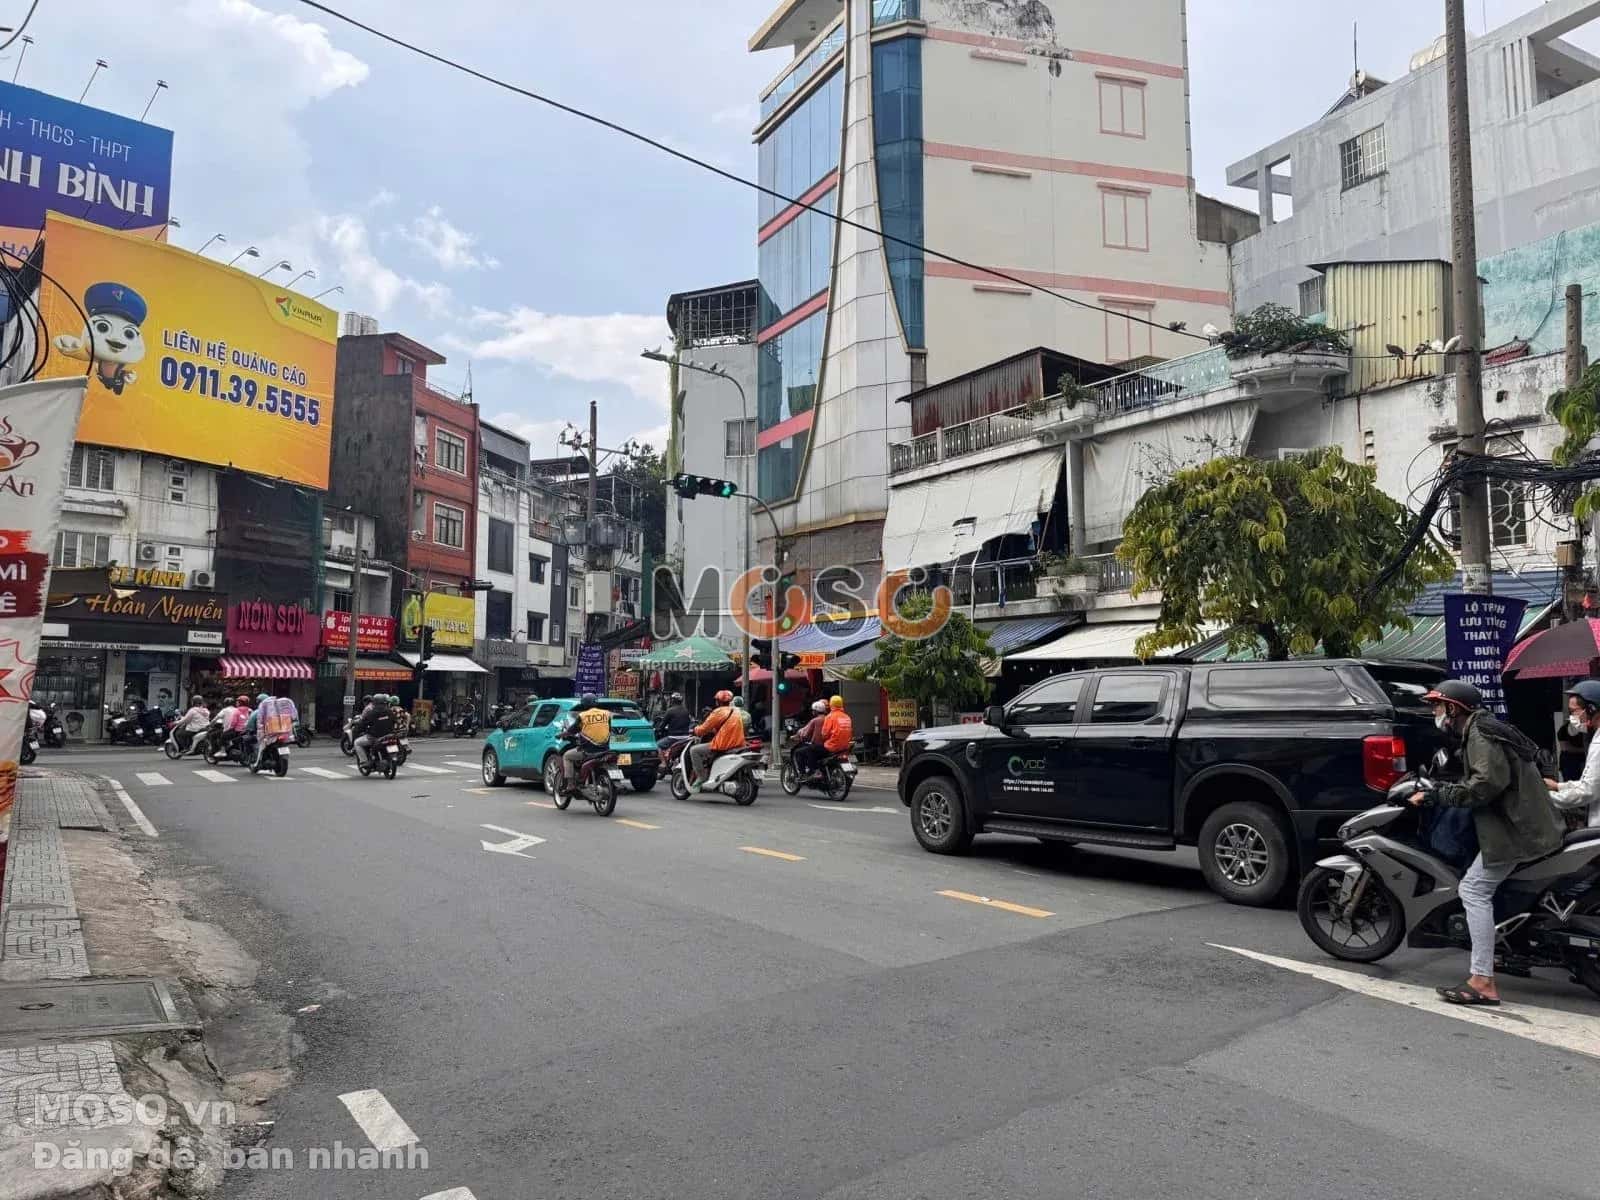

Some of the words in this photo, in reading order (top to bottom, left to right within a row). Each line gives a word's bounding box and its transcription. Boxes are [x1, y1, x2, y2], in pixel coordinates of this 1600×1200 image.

[29, 118, 74, 147] THCS
[91, 135, 132, 162] THPT
[57, 162, 155, 217] BÌNH
[163, 329, 201, 354] LIÊN
[206, 341, 227, 366] HỆ
[231, 349, 278, 377] QUẢNG
[281, 365, 307, 386] CÁO
[160, 356, 321, 426] 0911.39.5555
[134, 567, 186, 586] KÍNH
[147, 595, 223, 625] Nguyễn
[239, 597, 273, 633] NÓN
[276, 602, 307, 633] SƠN
[1464, 601, 1479, 614] LỘ
[366, 627, 389, 637] APPLE
